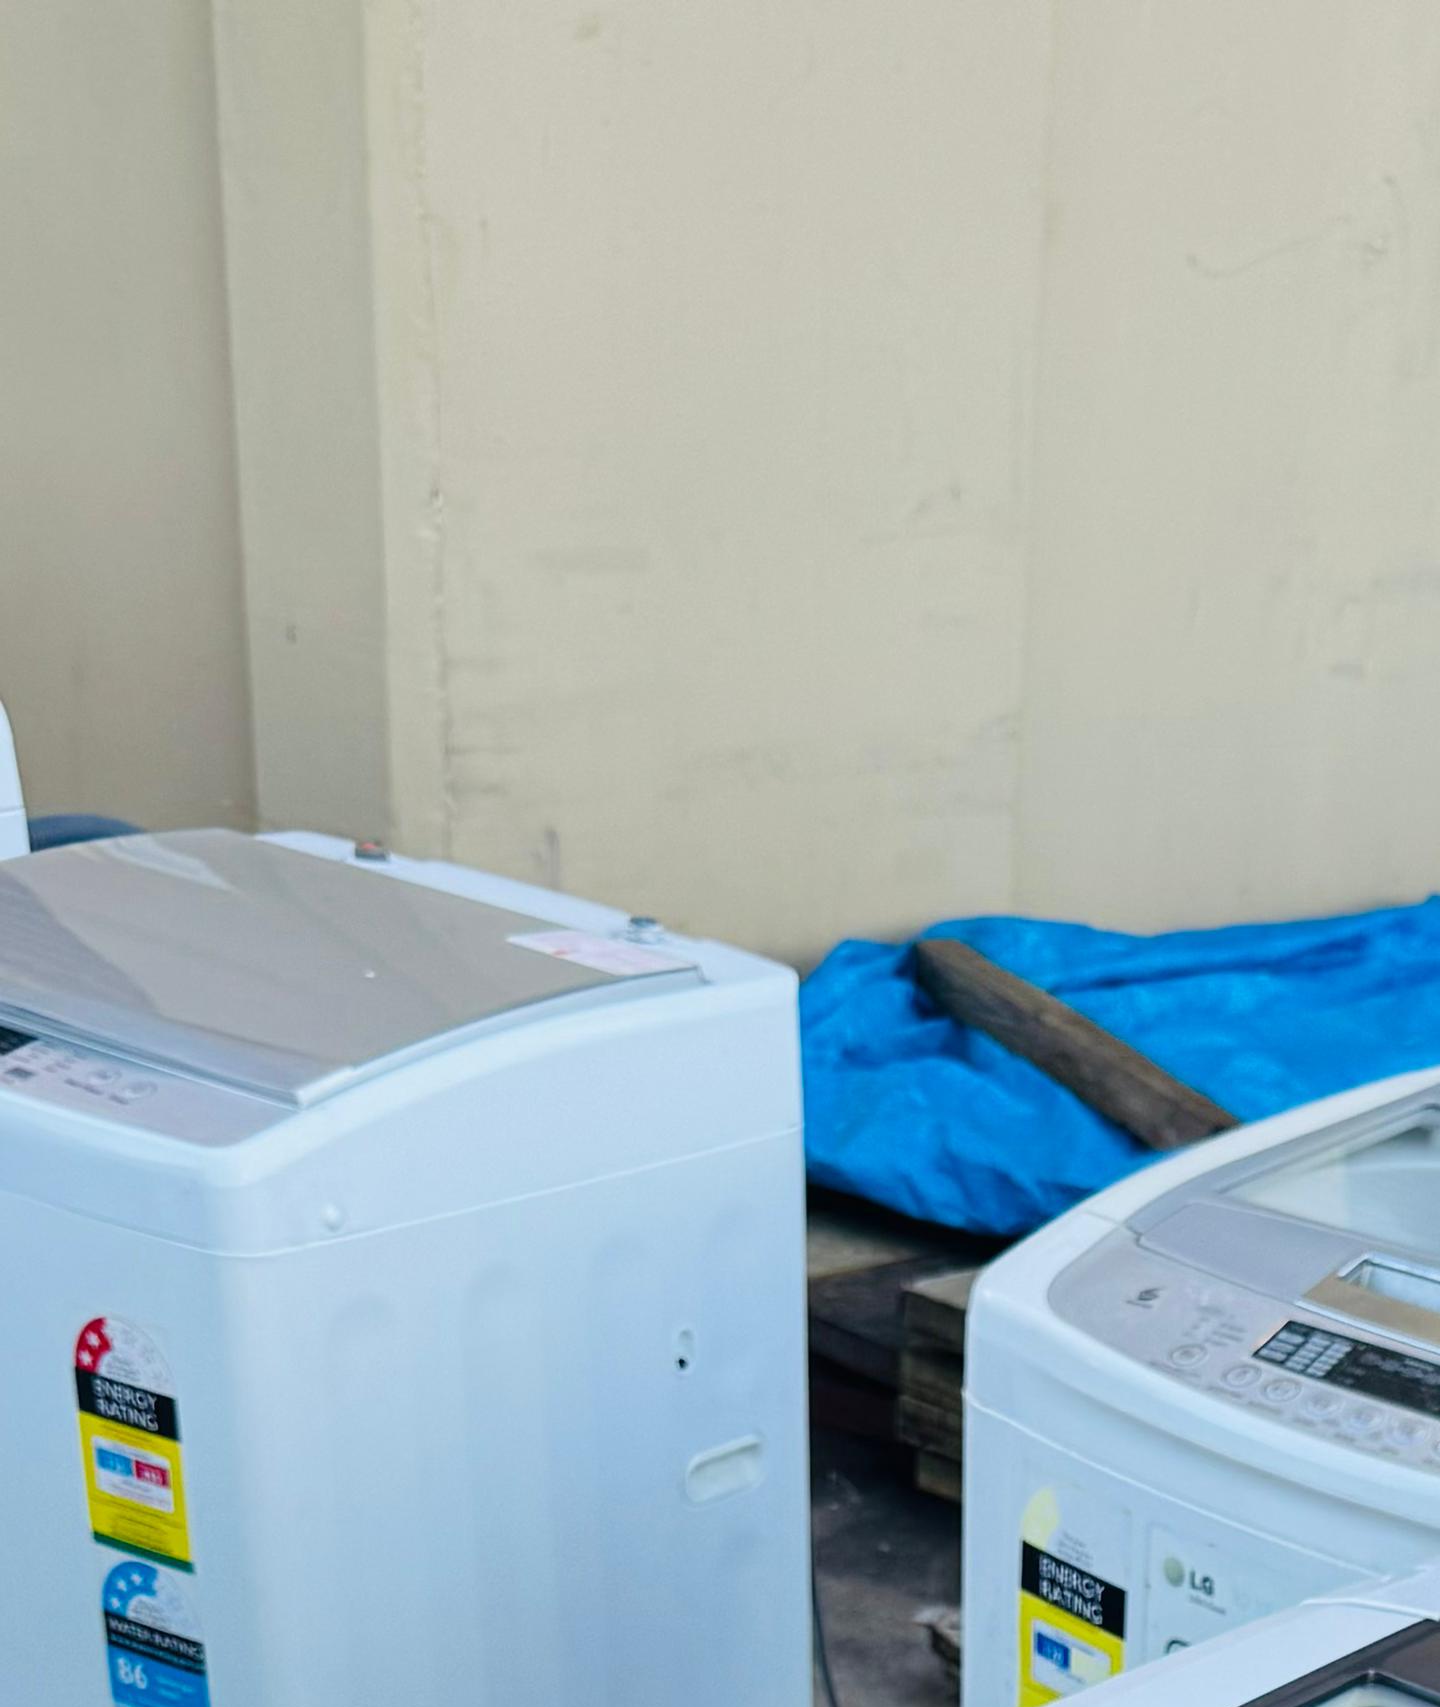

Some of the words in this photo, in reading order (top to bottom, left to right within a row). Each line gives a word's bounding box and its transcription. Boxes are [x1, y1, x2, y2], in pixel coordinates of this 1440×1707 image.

[1038, 1556, 1105, 1602] ENERGY
[1038, 1578, 1104, 1625] RATING
[1189, 1569, 1215, 1597] LG
